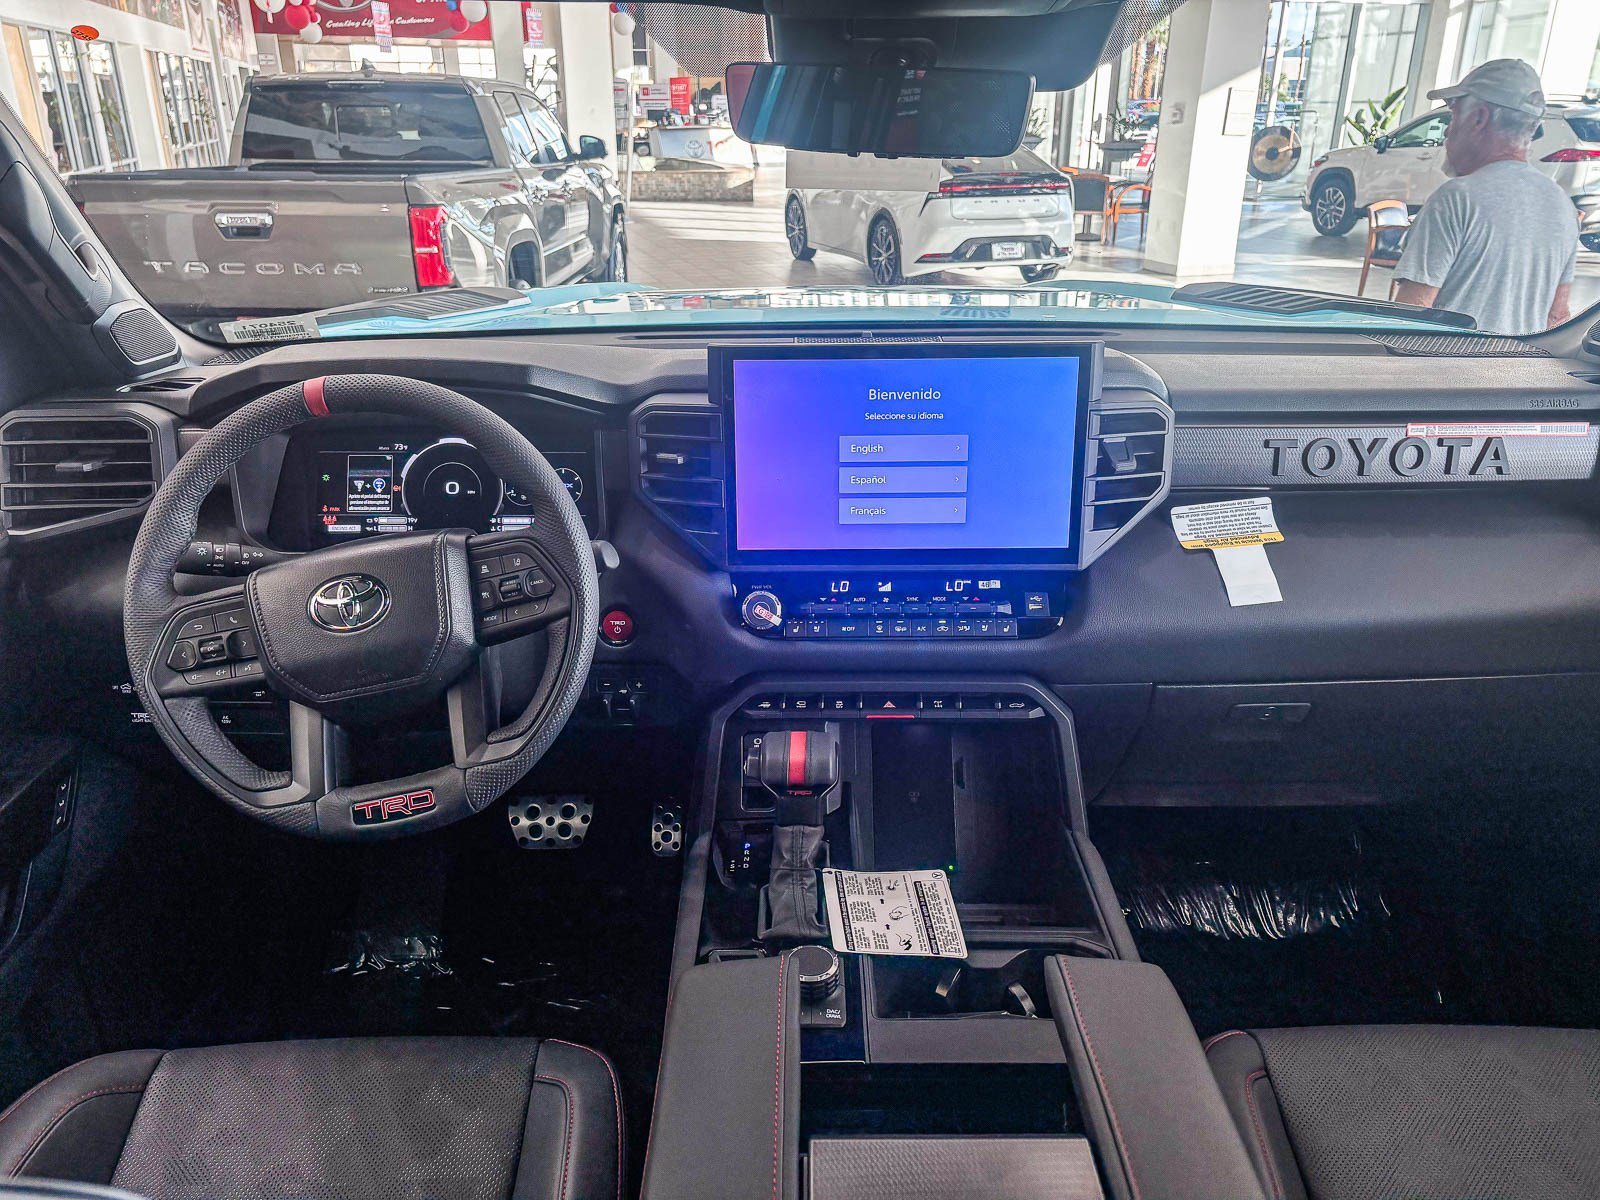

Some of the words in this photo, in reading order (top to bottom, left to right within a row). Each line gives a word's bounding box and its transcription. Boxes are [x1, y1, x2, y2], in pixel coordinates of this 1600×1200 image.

[144, 260, 363, 275] TACOMA
[869, 388, 941, 400] Bienvenido
[1530, 399, 1544, 408] SRS
[1546, 399, 1579, 408] AIRBAG
[851, 444, 884, 454] English
[1264, 437, 1512, 477] TOYOTA
[851, 476, 886, 485] Español
[446, 482, 459, 495] 0
[850, 507, 886, 516] Français
[354, 789, 434, 820] TRD
